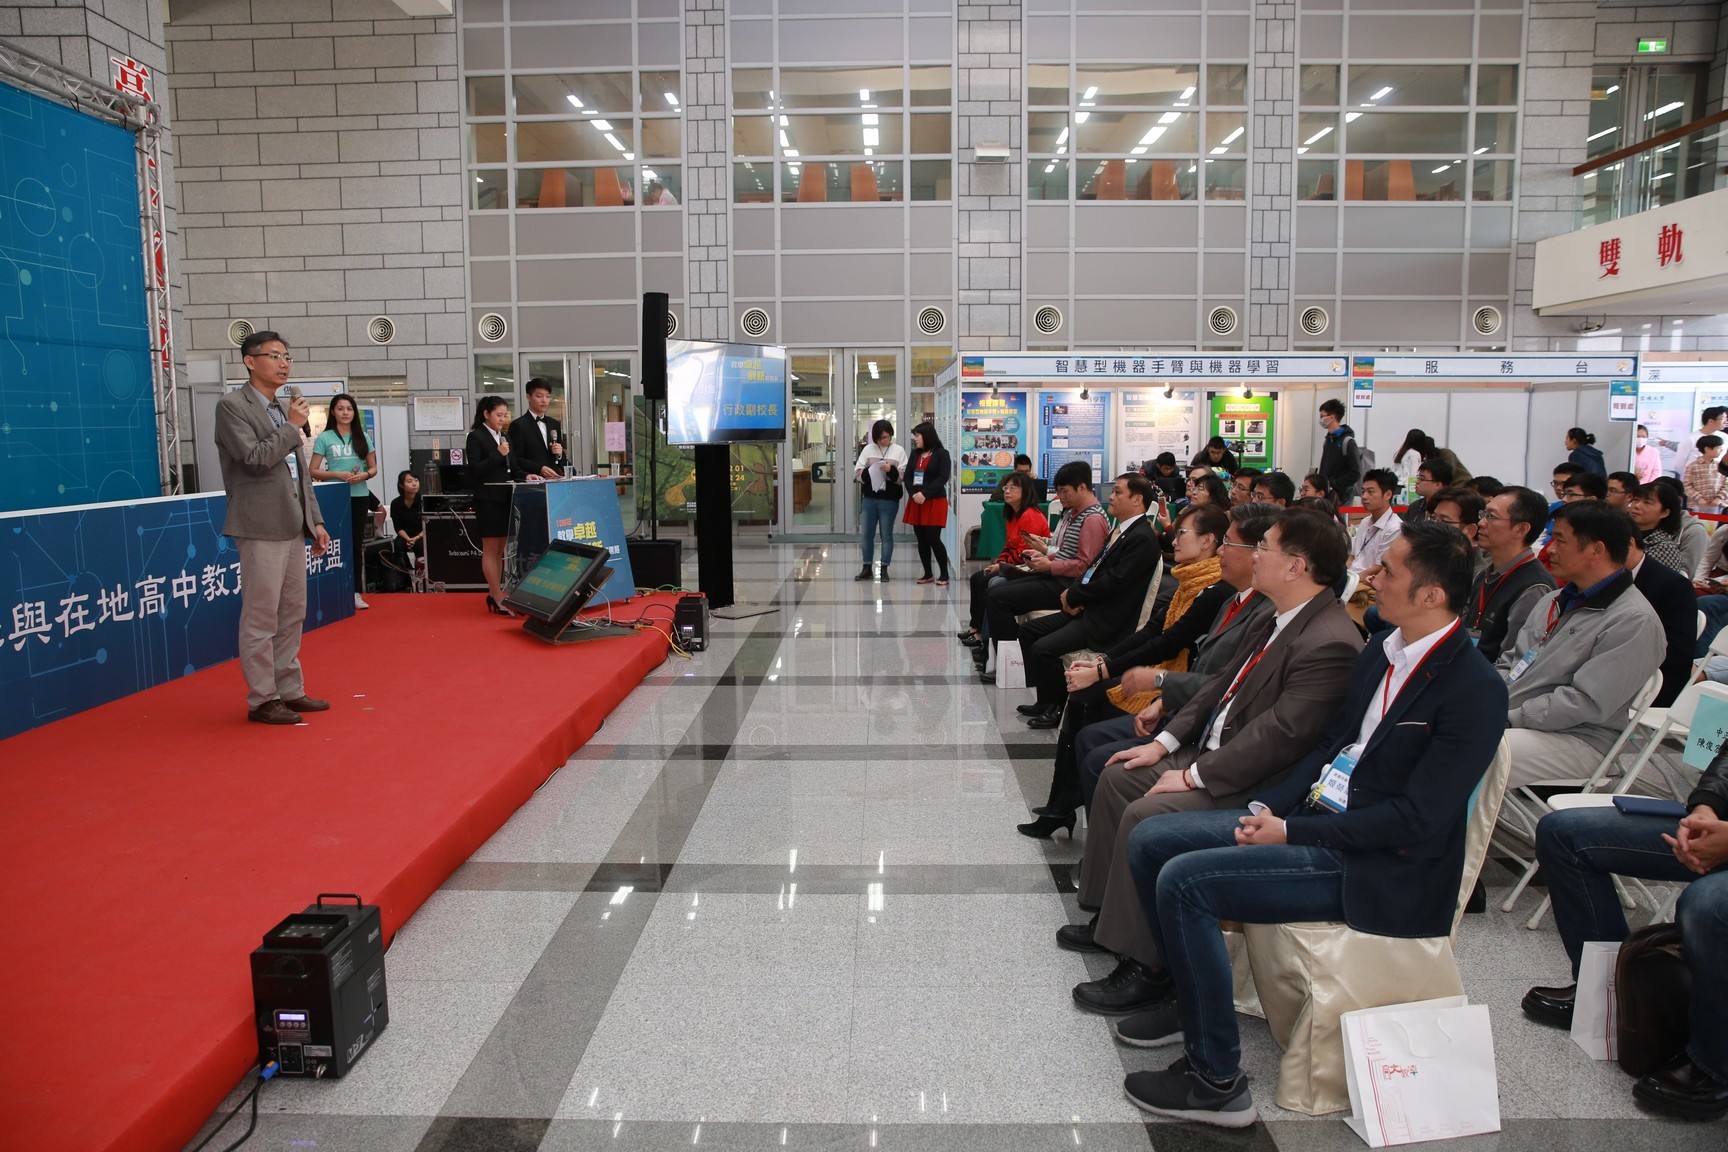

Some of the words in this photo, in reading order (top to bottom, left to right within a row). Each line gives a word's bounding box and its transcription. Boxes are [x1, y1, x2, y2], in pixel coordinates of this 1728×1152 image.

[1598, 223, 1684, 280] 雙軌
[1055, 359, 1280, 374] 智慧型機器手臂與機器學習
[1424, 360, 1589, 374] 服務台
[722, 403, 778, 416] 行政副校長
[331, 444, 359, 457] NU
[0, 560, 242, 652] 與在地高中教
